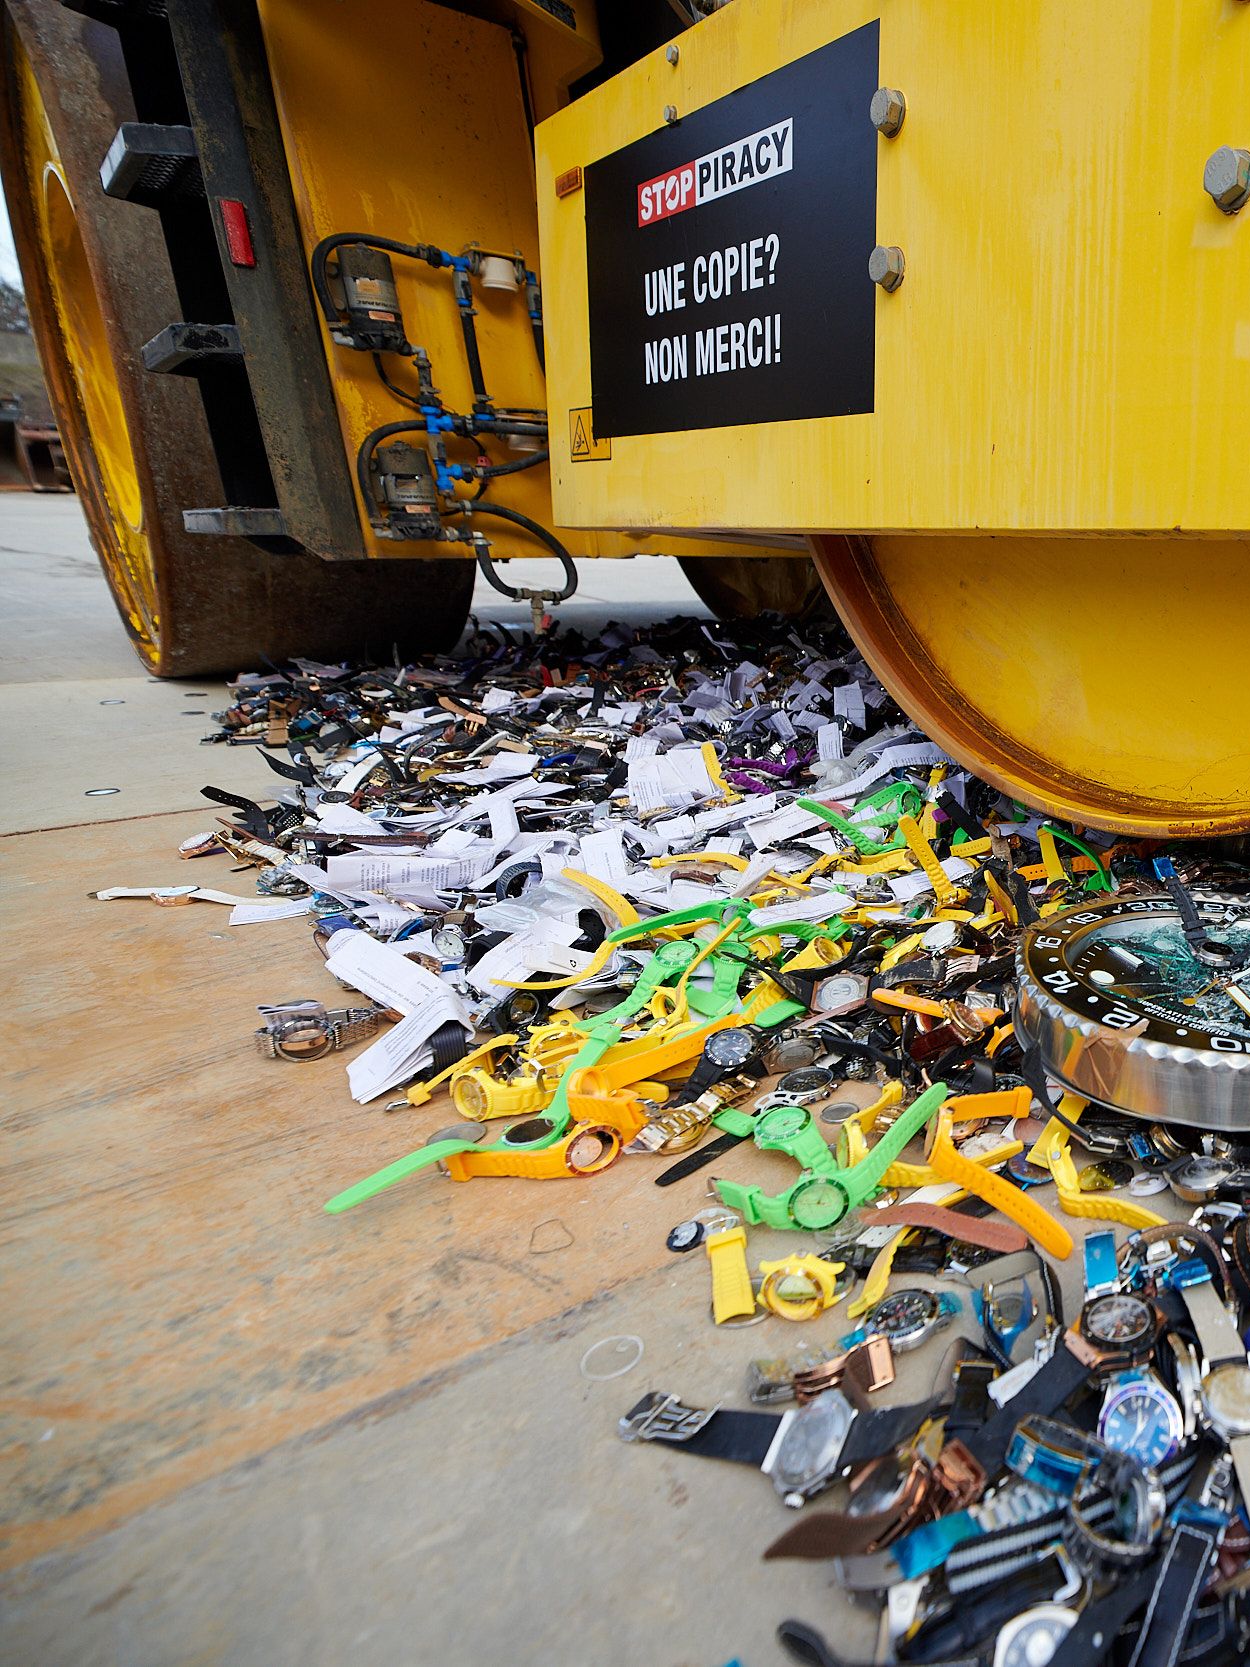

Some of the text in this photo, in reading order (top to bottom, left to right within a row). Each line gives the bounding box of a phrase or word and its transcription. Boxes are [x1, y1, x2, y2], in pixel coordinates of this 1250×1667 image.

[699, 126, 790, 198] PIRACY
[644, 233, 780, 316] UNE COPIE?
[644, 313, 781, 385] NON MERCI!
[1066, 912, 1104, 925] 18
[1034, 935, 1063, 950] 16
[1042, 970, 1079, 994] 14
[1144, 1007, 1188, 1026] OFFICIALLY
[1188, 1022, 1231, 1037] CERTIFIED
